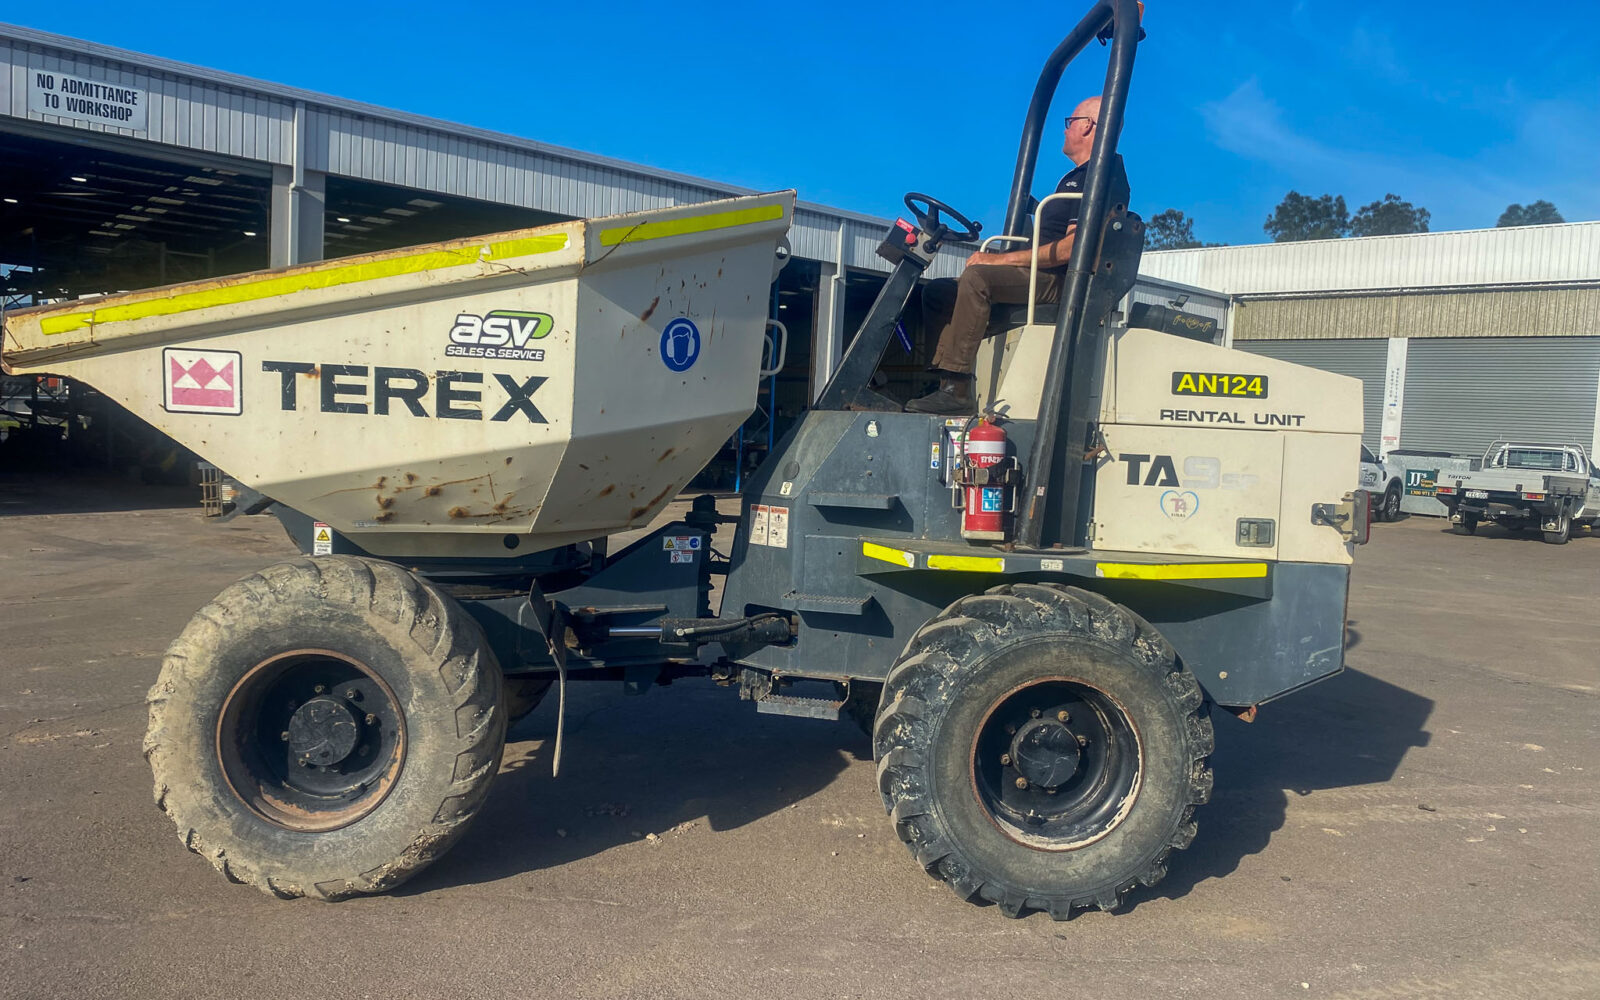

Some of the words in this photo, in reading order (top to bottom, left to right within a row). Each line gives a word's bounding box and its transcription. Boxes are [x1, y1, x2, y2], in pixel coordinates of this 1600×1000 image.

[37, 73, 54, 90] NO
[61, 78, 138, 106] ADMITTANCE
[43, 92, 60, 109] TO
[66, 96, 133, 122] WORKSHOP
[484, 347, 497, 358] &
[497, 348, 544, 360] SERVICE
[262, 360, 550, 425] TEREX
[1176, 373, 1263, 396] AN124
[1160, 409, 1246, 424] RENTAL
[1254, 413, 1305, 427] UNIT
